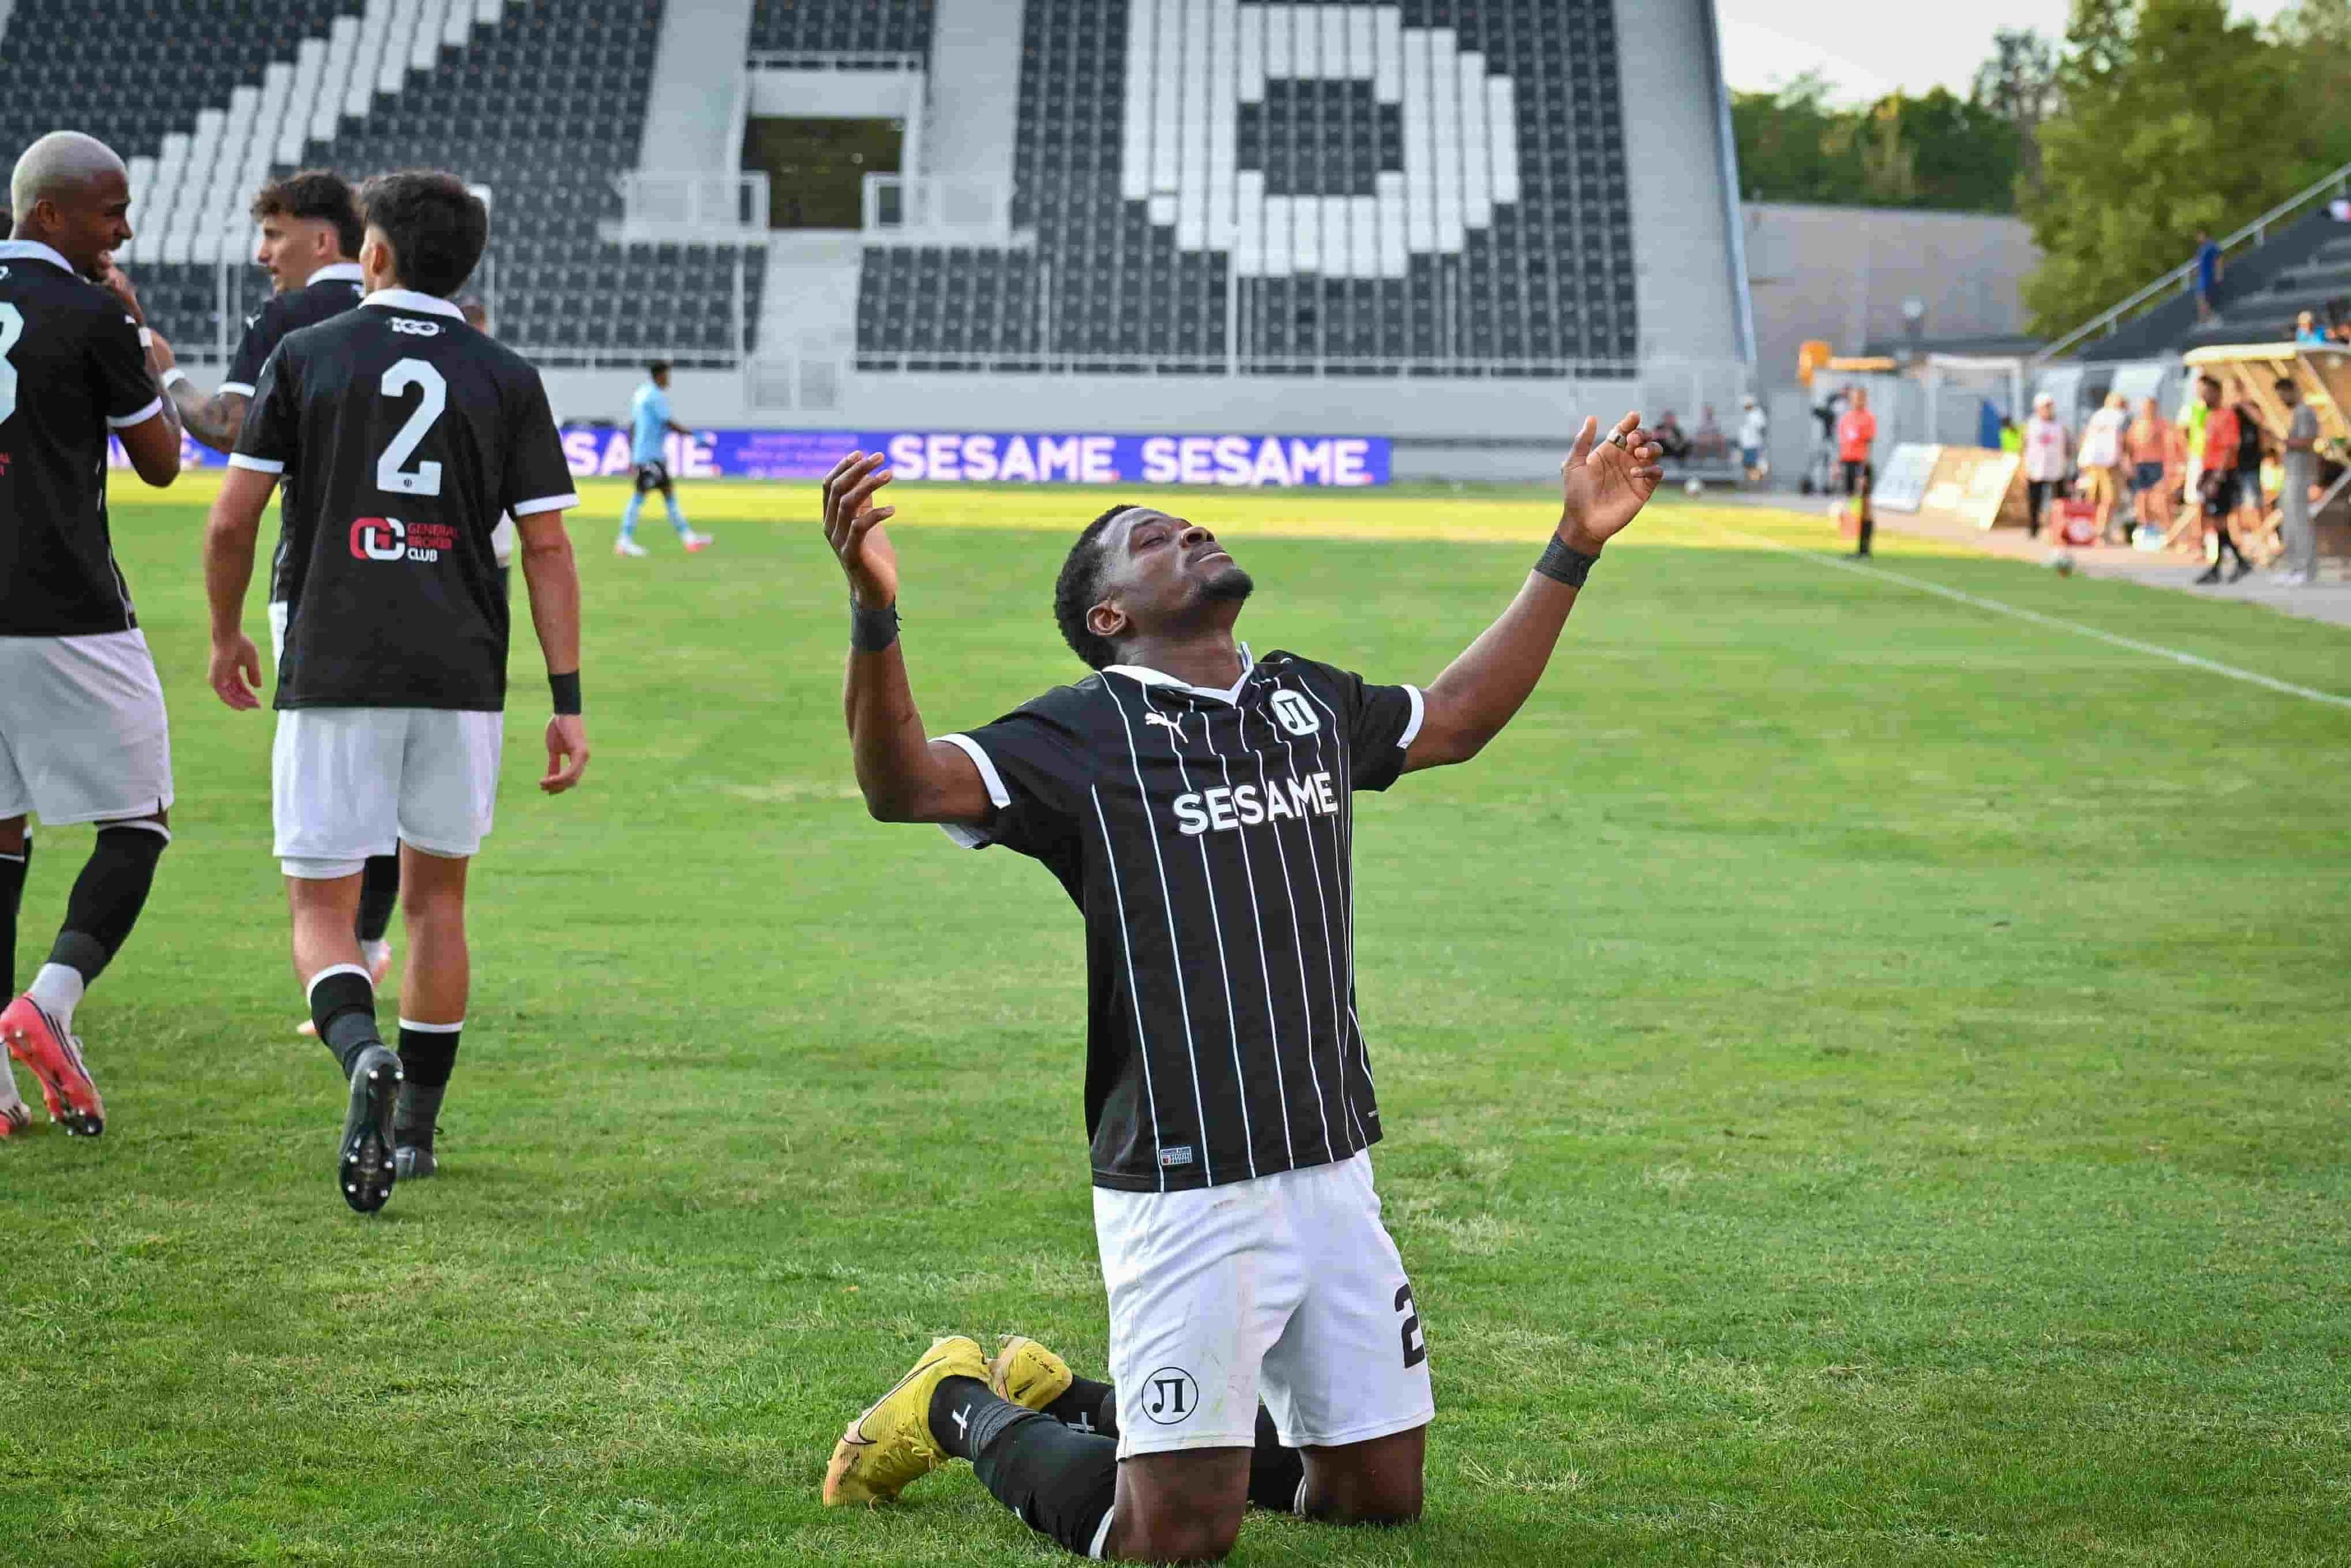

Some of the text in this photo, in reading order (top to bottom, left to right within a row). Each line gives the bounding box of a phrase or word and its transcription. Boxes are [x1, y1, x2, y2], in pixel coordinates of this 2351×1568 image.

[377, 358, 447, 496] 2
[407, 522, 460, 539] GENERAL
[407, 547, 438, 563] CLUB
[1172, 771, 1339, 836] SESAME
